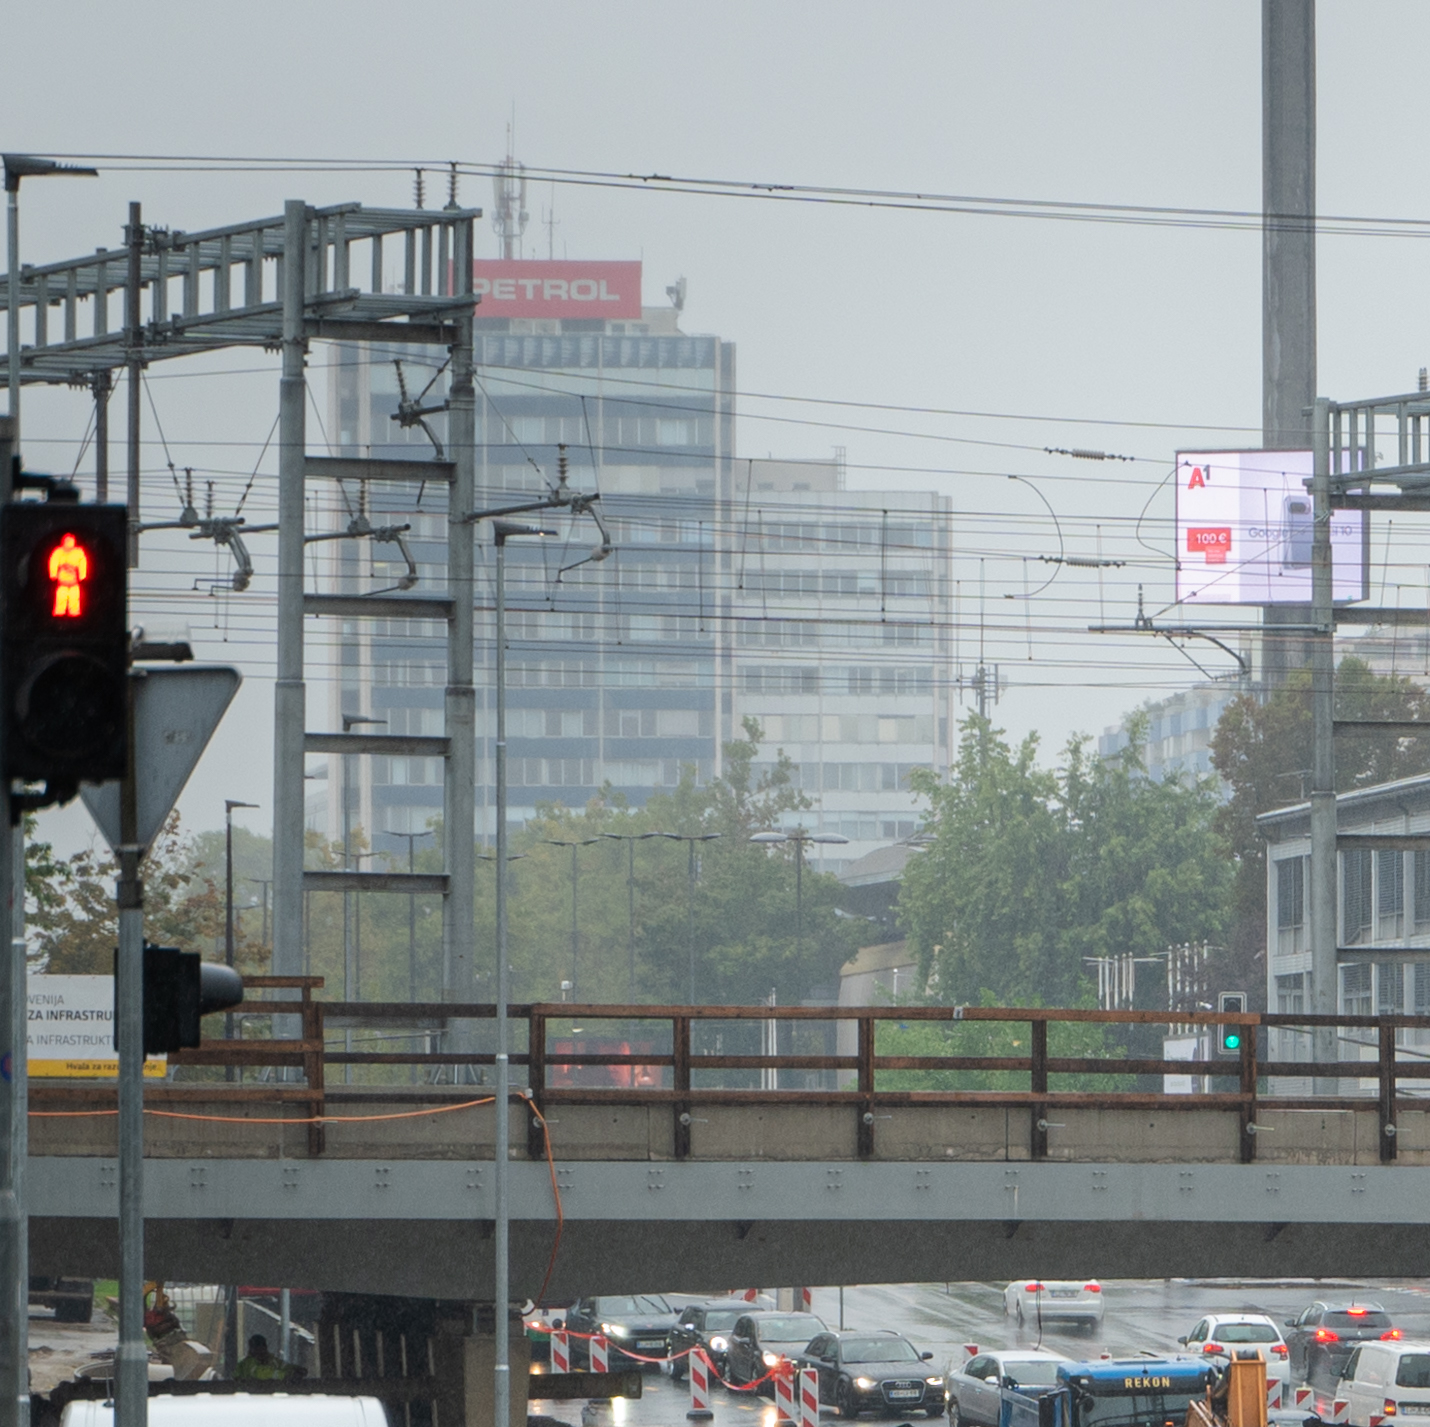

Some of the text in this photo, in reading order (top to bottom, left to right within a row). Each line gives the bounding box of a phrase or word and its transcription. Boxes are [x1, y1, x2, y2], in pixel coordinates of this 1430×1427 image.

[473, 278, 620, 301] PETROL
[27, 994, 65, 1006] VENIJA
[28, 1010, 114, 1021] ZA INFRASTRU
[37, 1035, 114, 1046] INFRASTRUKT
[66, 1063, 90, 1071] Hvala
[1124, 1376, 1170, 1388] REKON
